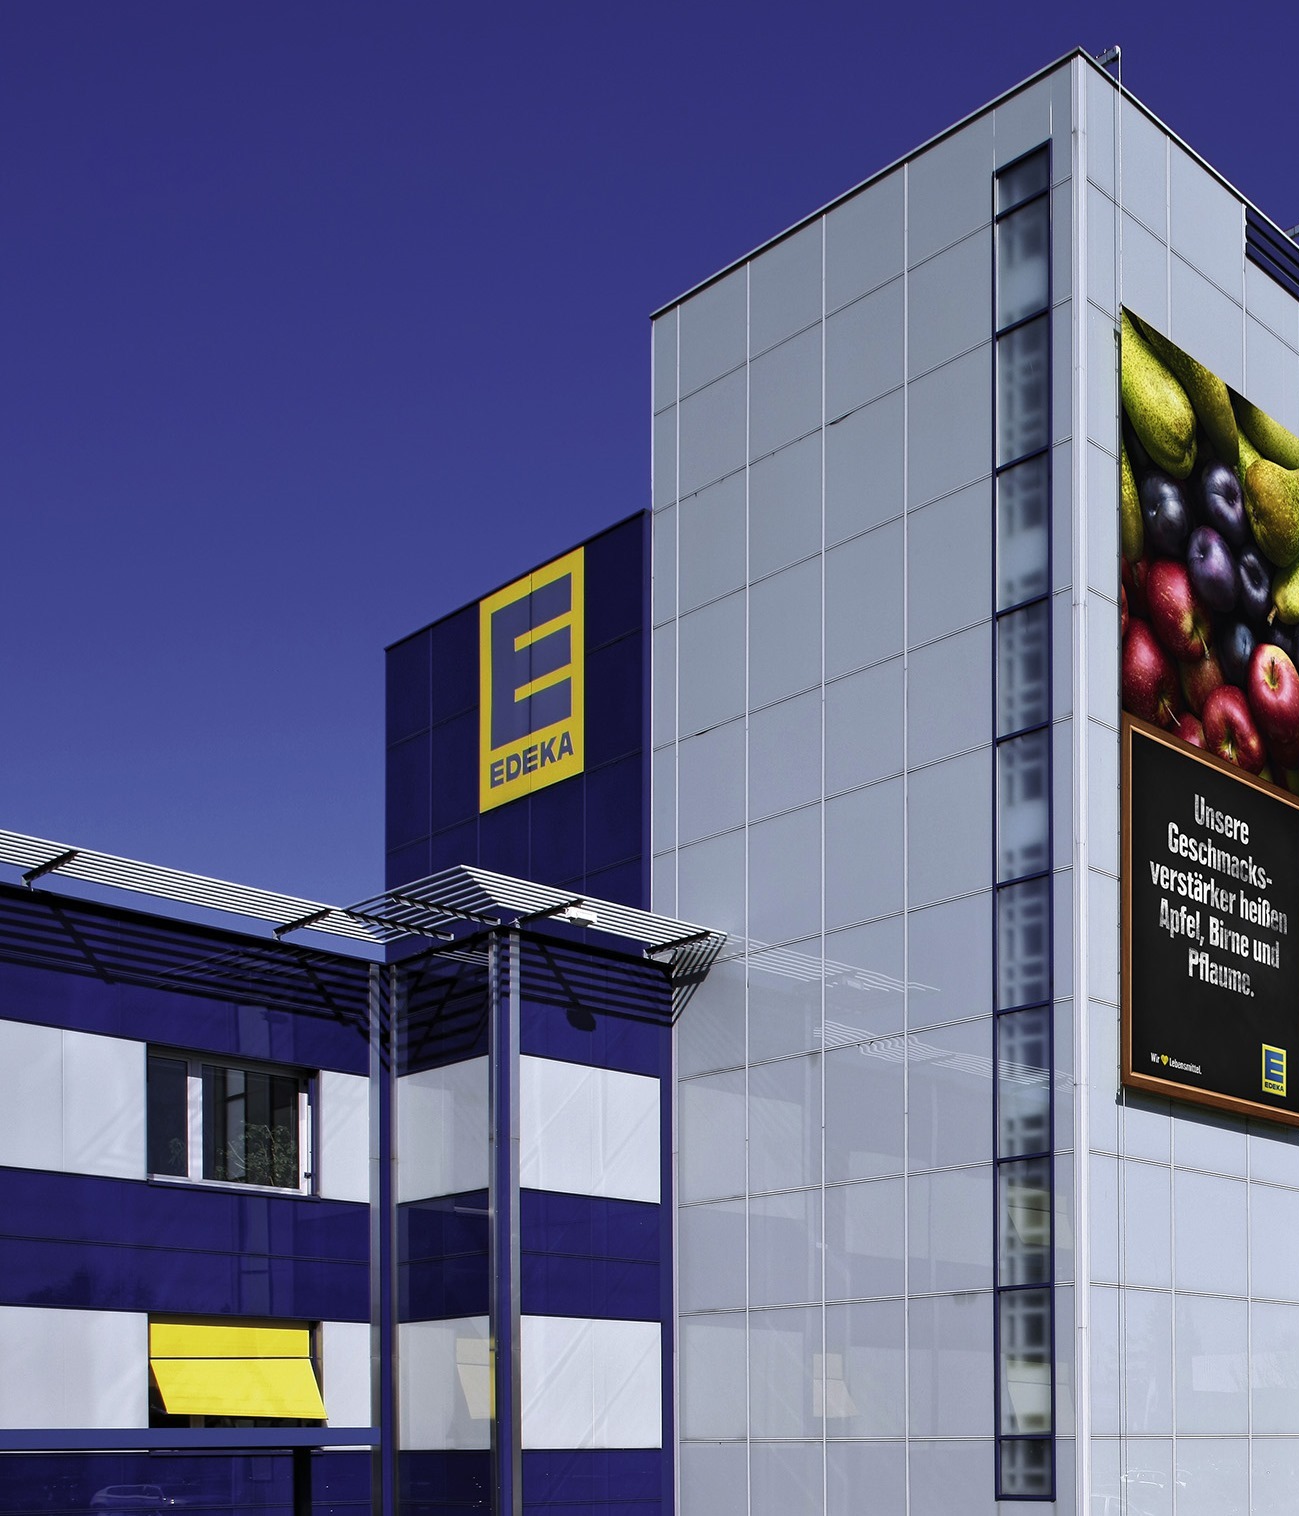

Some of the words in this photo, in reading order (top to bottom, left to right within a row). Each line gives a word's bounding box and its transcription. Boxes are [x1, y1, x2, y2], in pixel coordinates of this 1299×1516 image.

[490, 572, 572, 751] E
[490, 731, 574, 790] EDEKA
[1194, 793, 1250, 845] Unsere
[1167, 821, 1273, 890] Geschmacks-
[1149, 860, 1236, 915] verstärker
[1239, 889, 1288, 935] heißen
[1159, 897, 1205, 947] Apfel,
[1209, 915, 1250, 958] Birne
[1252, 938, 1280, 969] und
[1188, 947, 1255, 998] Pflaume.
[1150, 1052, 1160, 1064] Wir
[1264, 1081, 1285, 1093] EDEKA
